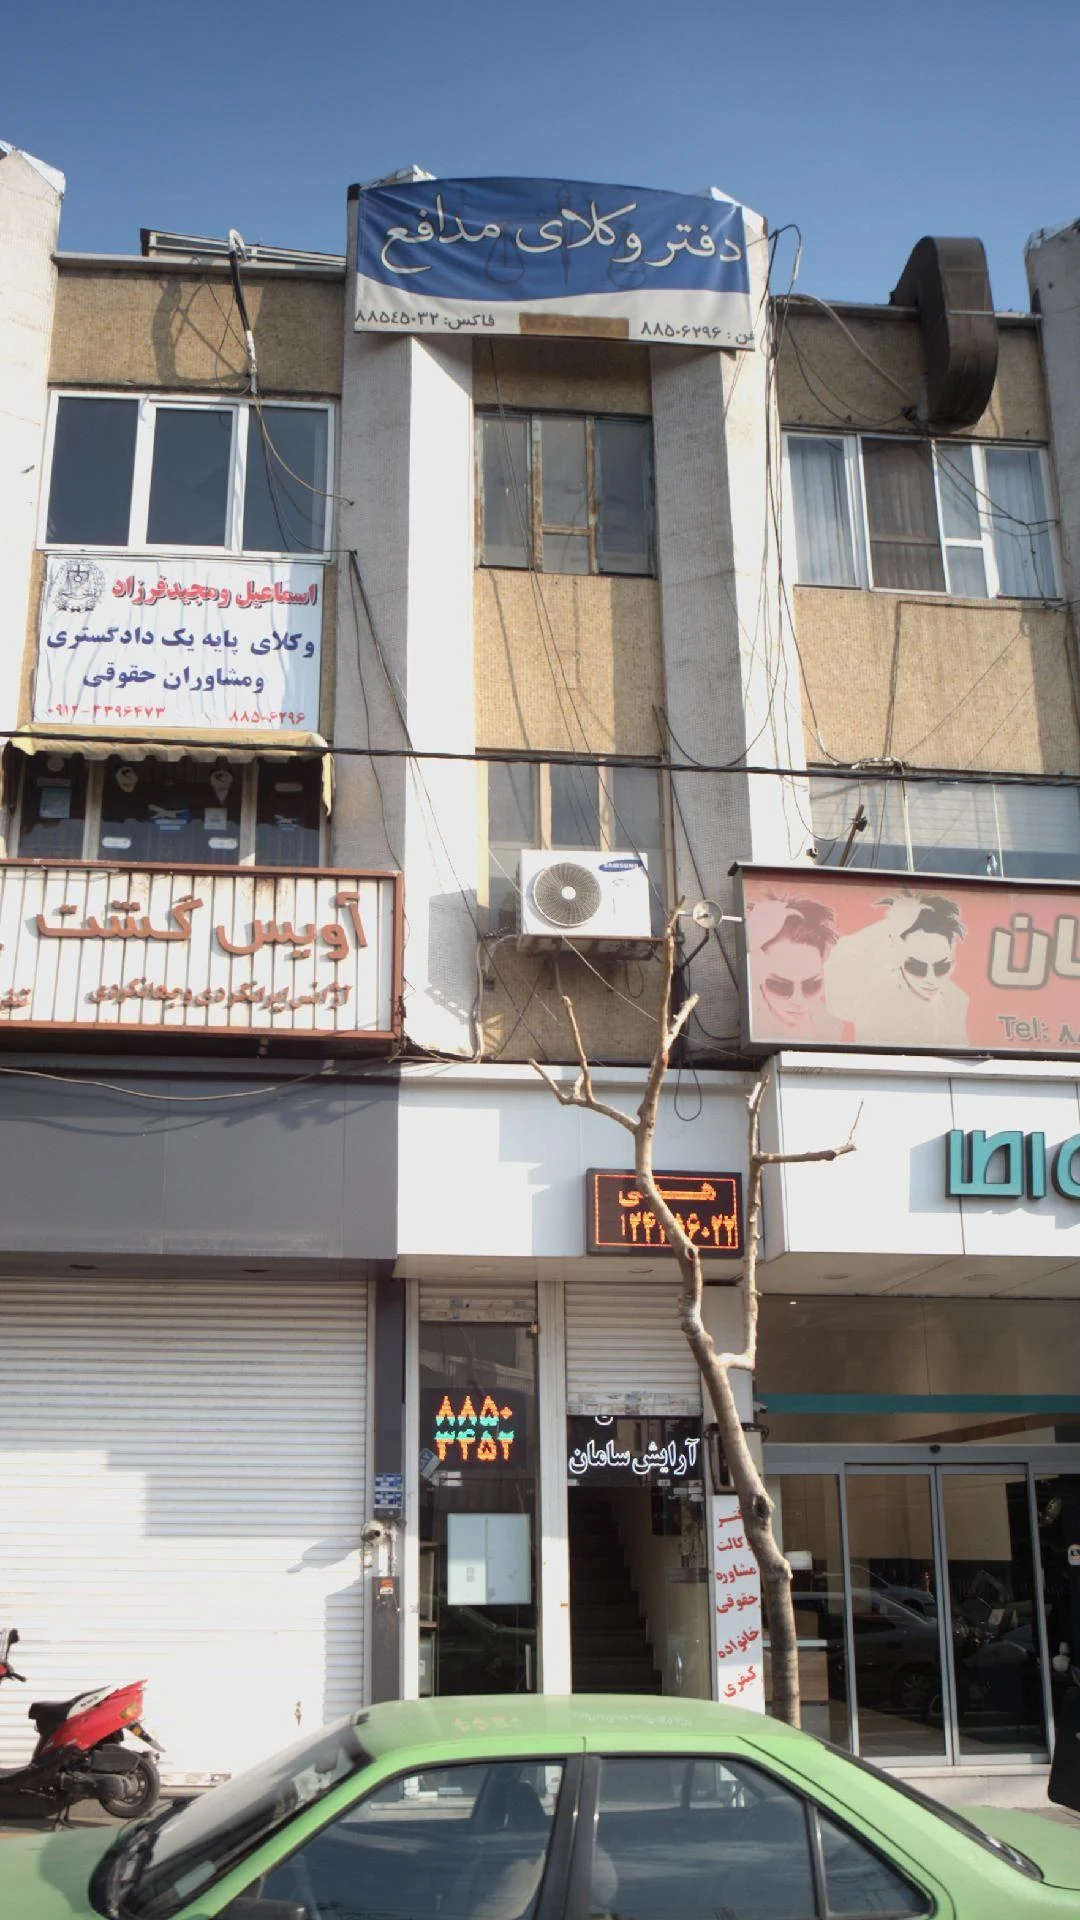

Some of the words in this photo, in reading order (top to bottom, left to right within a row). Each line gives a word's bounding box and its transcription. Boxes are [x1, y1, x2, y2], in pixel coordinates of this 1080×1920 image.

[381, 194, 500, 274] مدافع
[644, 224, 743, 267] دفتر
[236, 581, 318, 609] اسماعیل
[47, 626, 154, 650] دادگستری
[161, 628, 195, 652] یک
[202, 629, 239, 656] پایه
[82, 661, 157, 688] حقوقی
[36, 894, 204, 942] گشت
[215, 891, 367, 960] آویس
[435, 1395, 513, 1426] ۸۸۵۰
[568, 1439, 631, 1475] سامان
[632, 1437, 700, 1476] آرایش
[716, 1564, 757, 1584] مشاوره
[716, 1593, 758, 1614] حقوقی
[718, 1626, 759, 1658] خانواده
[723, 1665, 757, 1698] کیفری
